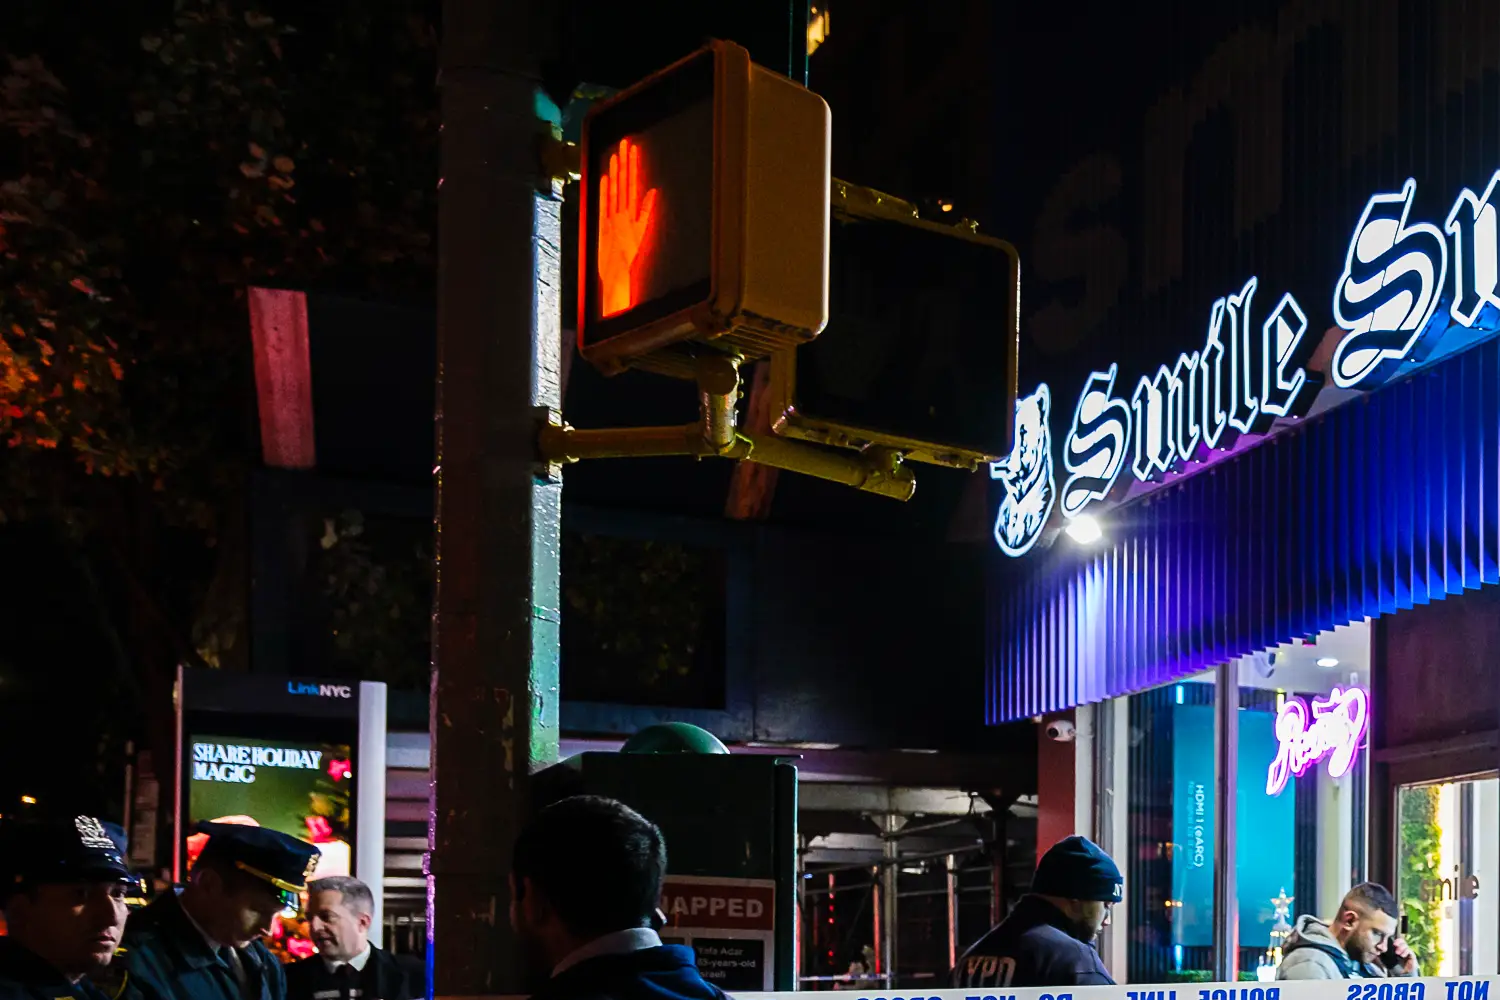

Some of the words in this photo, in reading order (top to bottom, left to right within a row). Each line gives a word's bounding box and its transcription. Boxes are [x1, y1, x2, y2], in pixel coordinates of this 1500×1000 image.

[1062, 276, 1309, 517] Smile
[287, 681, 351, 698] LinkNYC
[192, 743, 251, 764] SHARE
[251, 746, 322, 769] HOLIDAY
[192, 762, 256, 783] MAGIC
[955, 954, 1017, 987] YPD
